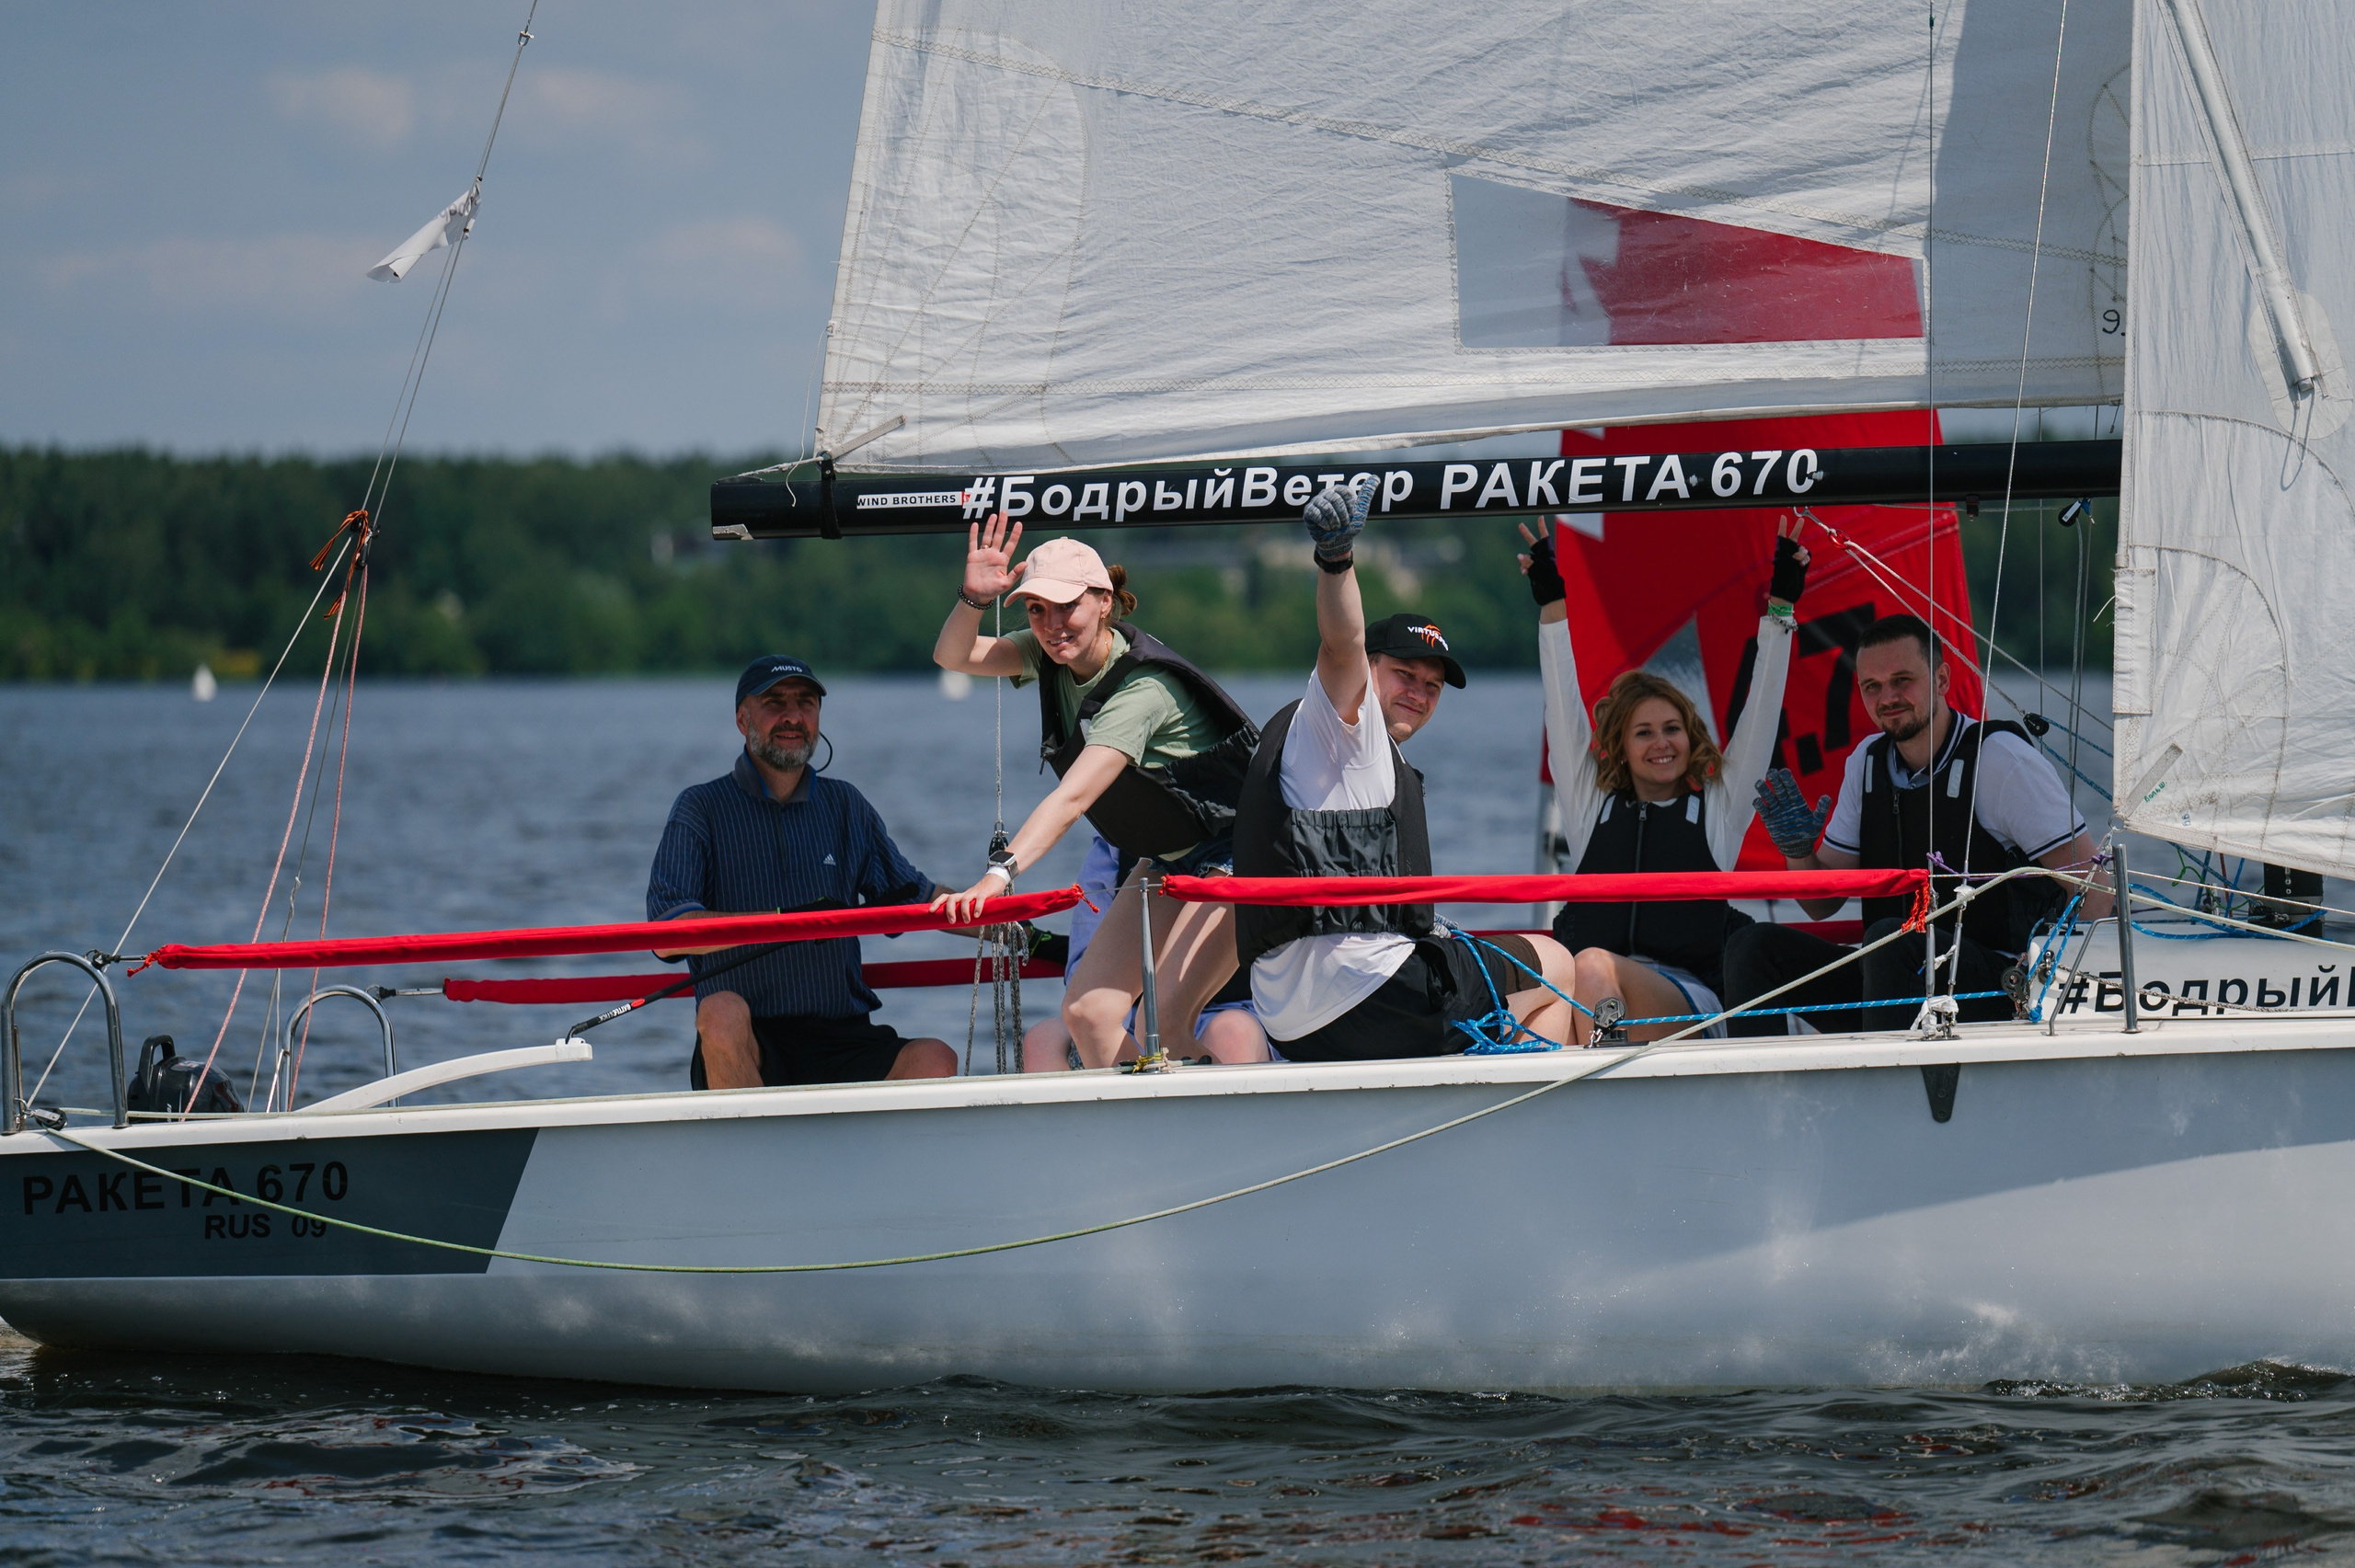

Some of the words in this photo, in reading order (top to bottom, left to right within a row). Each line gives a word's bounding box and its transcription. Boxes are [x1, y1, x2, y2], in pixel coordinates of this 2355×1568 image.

[1440, 454, 1691, 509] РАКЕТА
[1711, 448, 1819, 498] 670
[856, 498, 888, 507] WIND
[892, 494, 956, 506] BROTHERS
[1407, 626, 1449, 651] VIRTUS
[771, 665, 803, 673] MUSTO
[2057, 964, 2355, 1016] #Бодрый
[22, 1166, 241, 1216] РАКЕТА
[256, 1161, 349, 1206] 670
[203, 1213, 271, 1240] RUS
[292, 1212, 327, 1238] 09
